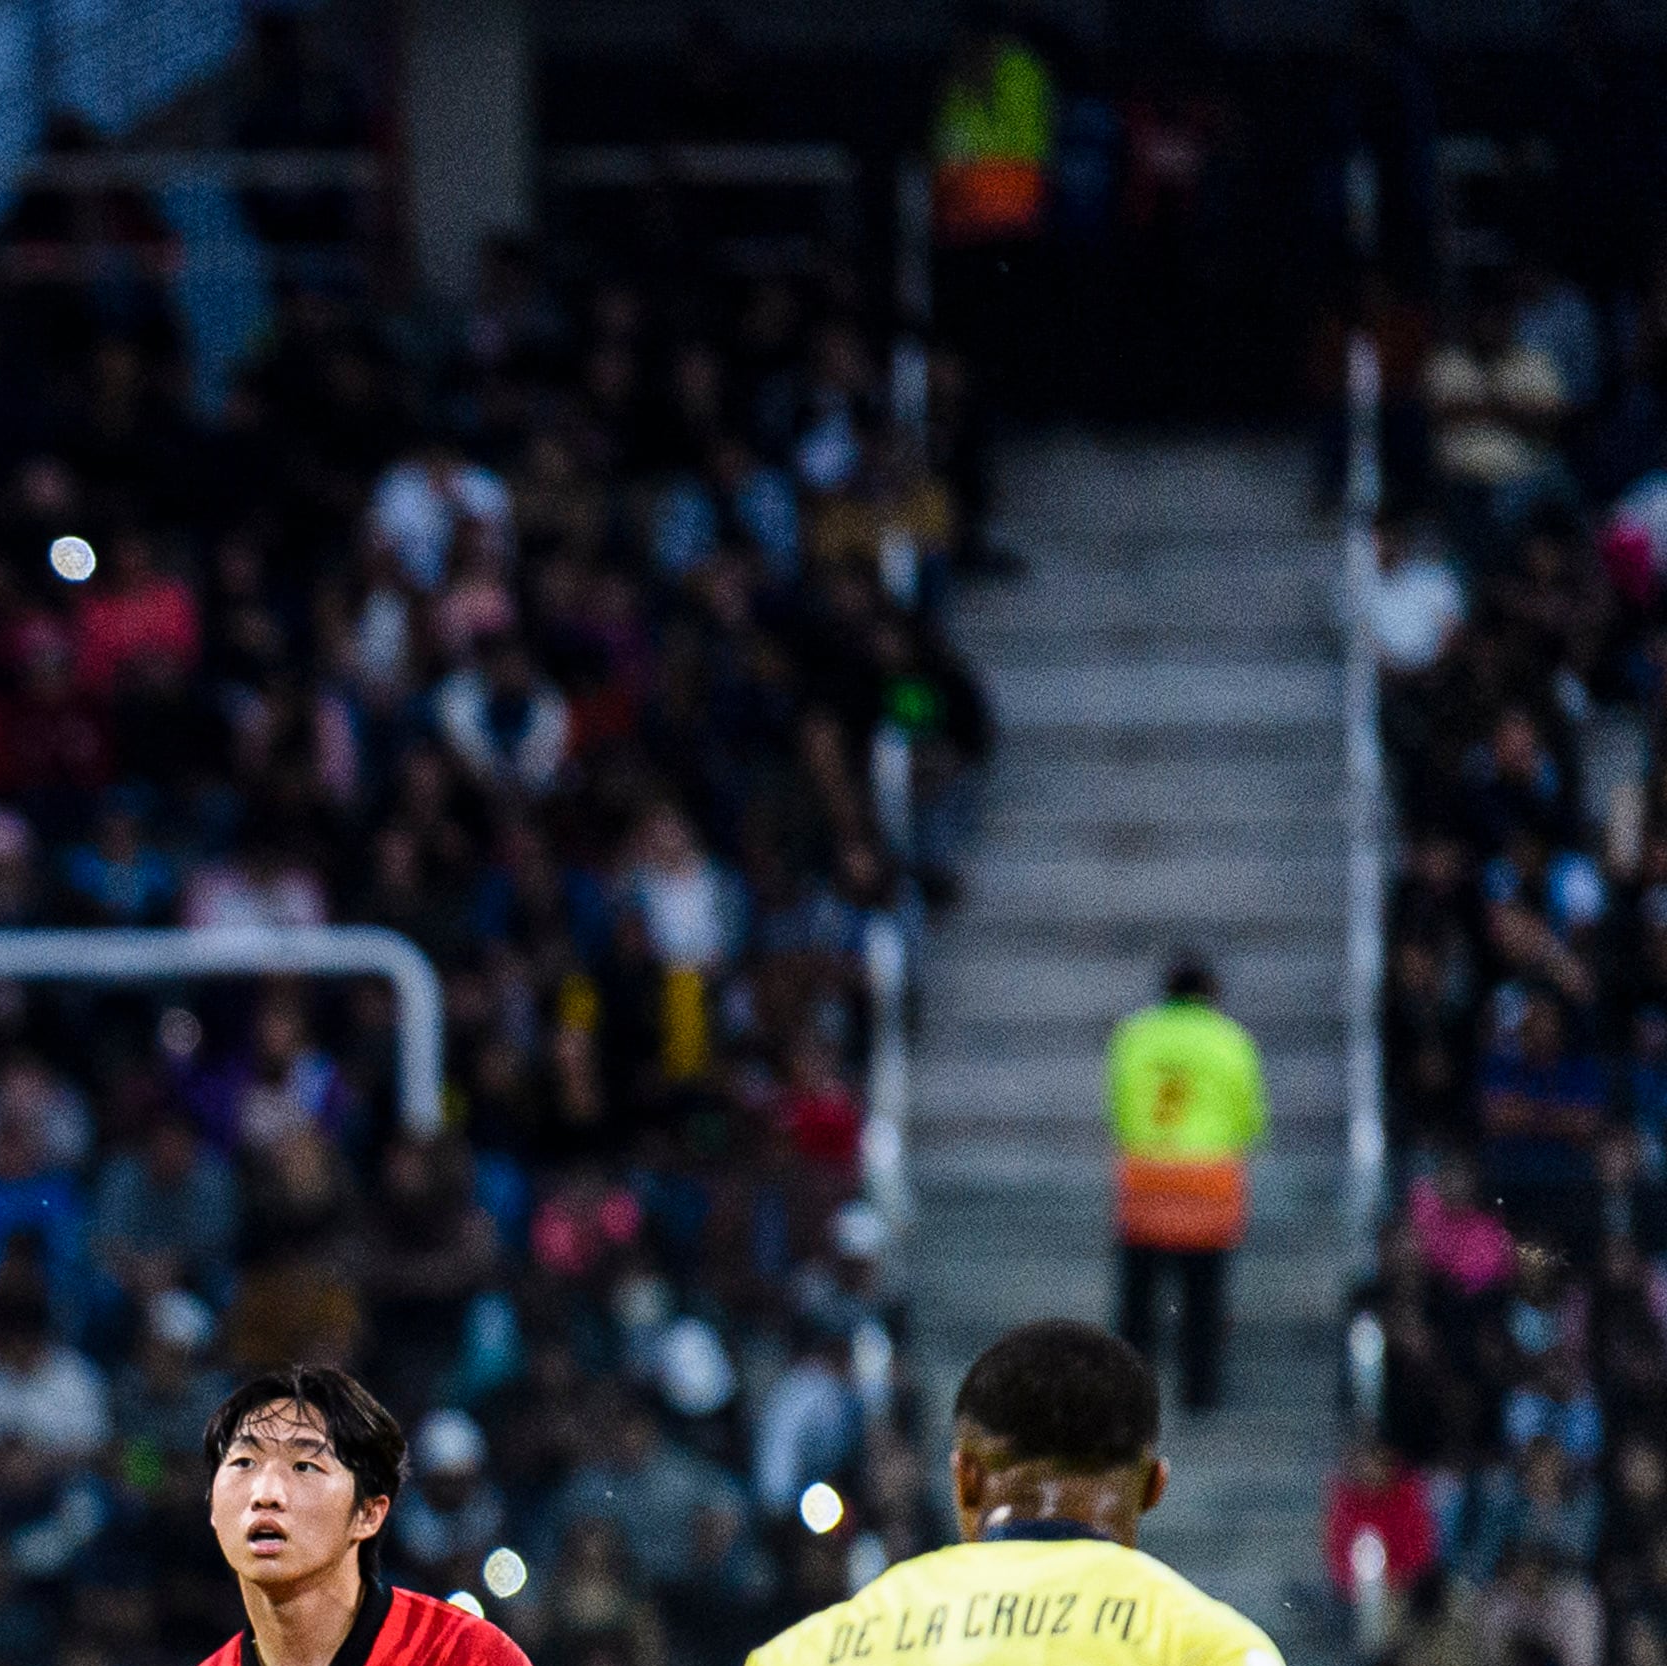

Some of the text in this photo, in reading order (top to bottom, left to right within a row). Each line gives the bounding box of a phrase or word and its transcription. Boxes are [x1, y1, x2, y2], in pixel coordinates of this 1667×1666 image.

[828, 1615, 881, 1664] DE
[894, 1604, 948, 1652] LA
[964, 1591, 1080, 1639] CRUZ
